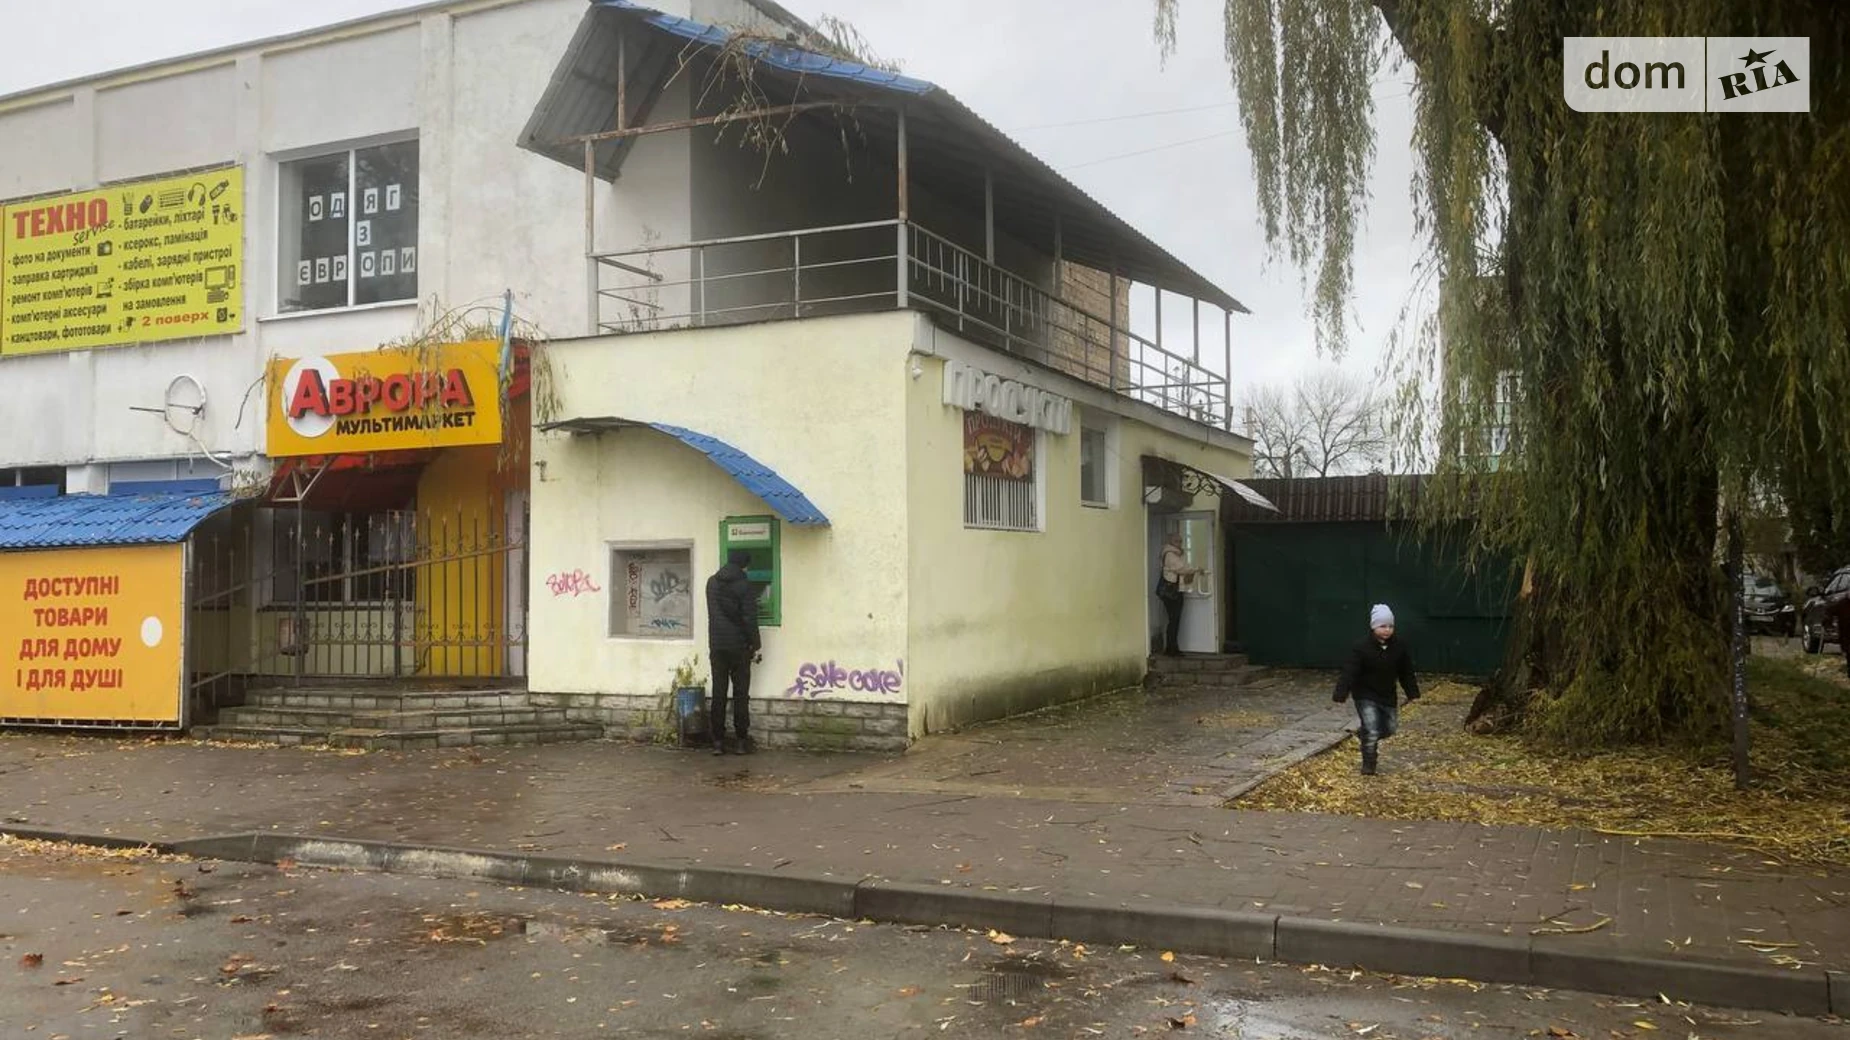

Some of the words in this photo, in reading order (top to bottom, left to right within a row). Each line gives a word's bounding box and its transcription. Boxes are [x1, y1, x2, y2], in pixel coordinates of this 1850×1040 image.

[311, 190, 398, 216] ОДЯГ
[13, 198, 108, 239] ТЕХНО
[123, 213, 172, 231] батарейки,
[174, 206, 205, 224] ліхтарі
[123, 236, 162, 252] ксерокс,
[164, 228, 208, 246] ламінація
[12, 254, 34, 267] фото
[35, 252, 45, 263] на
[46, 246, 91, 262] документи
[123, 255, 155, 271] кабелі,
[156, 249, 191, 269] зарядні
[193, 244, 232, 264] пристрої
[300, 251, 414, 281] ЄВРОПИ
[13, 272, 50, 287] заправка
[51, 262, 98, 281] картриджів
[123, 277, 150, 293] збірка
[152, 270, 203, 287] комп'ютерів
[11, 292, 41, 307] ремонт
[42, 283, 93, 303] комп'ютерів
[123, 300, 134, 311] на
[135, 294, 186, 310] замовлення
[11, 305, 61, 324] комп'ютерні
[62, 304, 107, 319] аксесуари
[141, 316, 151, 326] 2
[155, 310, 209, 325] поверх
[11, 331, 60, 344] канцтовари,
[61, 323, 112, 340] фототовари
[24, 576, 119, 600] ДОСТУПНІ
[33, 607, 108, 627] ТОВАРИ
[19, 638, 59, 660] ДЛЯ
[63, 638, 122, 660] ДОМУ
[17, 669, 22, 687] І
[25, 669, 66, 691] ДЛЯ
[70, 669, 123, 691] ДУШІ
